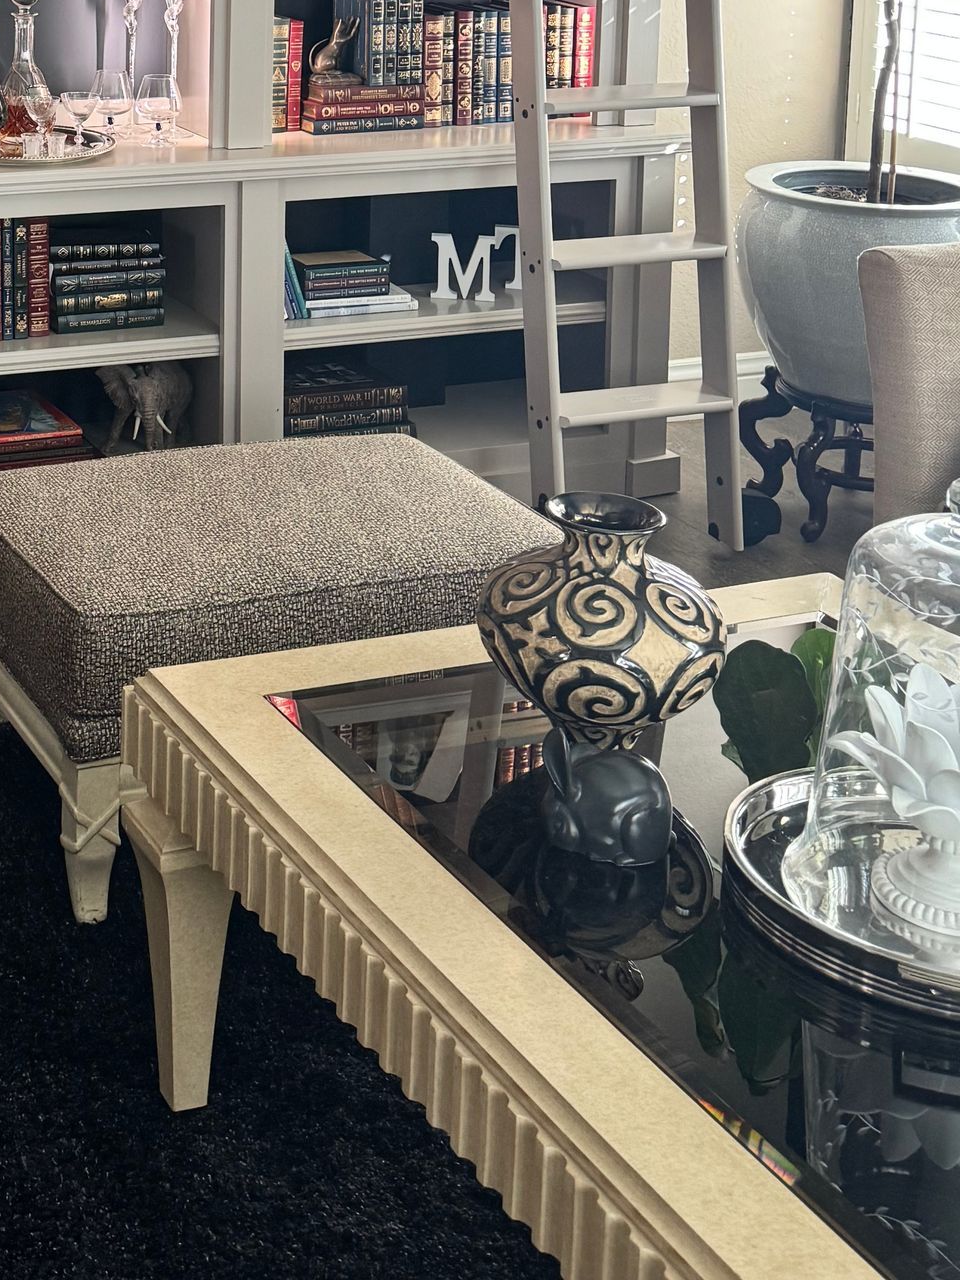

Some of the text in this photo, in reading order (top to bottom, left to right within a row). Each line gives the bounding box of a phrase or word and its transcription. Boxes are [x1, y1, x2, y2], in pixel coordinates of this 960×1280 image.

[307, 392, 371, 406] WORLD WAR II
[325, 414, 353, 427] World
[352, 412, 369, 426] War
